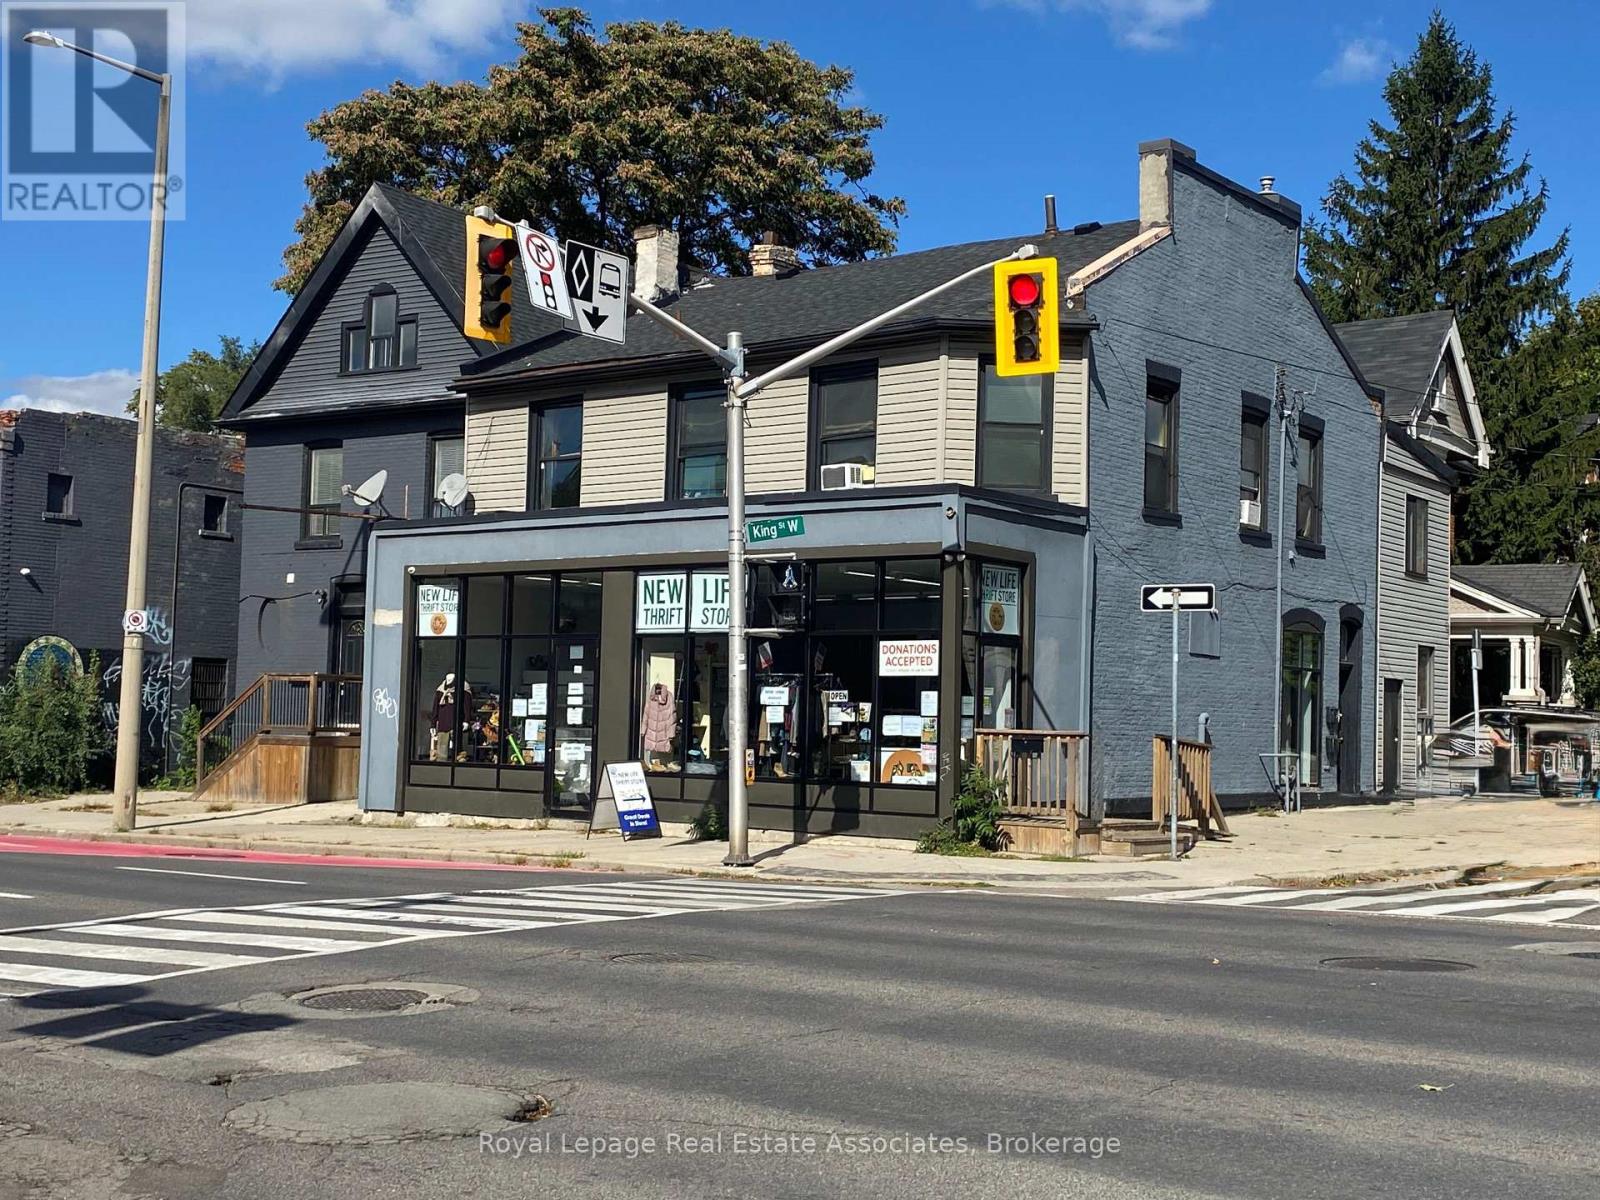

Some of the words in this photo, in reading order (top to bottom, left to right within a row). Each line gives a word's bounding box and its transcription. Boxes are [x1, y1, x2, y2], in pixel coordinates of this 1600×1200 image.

[753, 524, 777, 538] King
[778, 521, 785, 529] St
[787, 519, 798, 532] W
[1000, 571, 1017, 589] LIFE
[421, 588, 441, 601] NEW
[442, 589, 458, 601] LIF
[644, 578, 684, 605] NEW
[703, 578, 729, 604] LIF
[998, 590, 1016, 603] STORE
[643, 607, 683, 625] THRIFT
[701, 607, 730, 625] STOR
[882, 644, 937, 655] DONATIONS
[885, 656, 933, 667] ACCEPTED
[830, 692, 847, 700] OPEN
